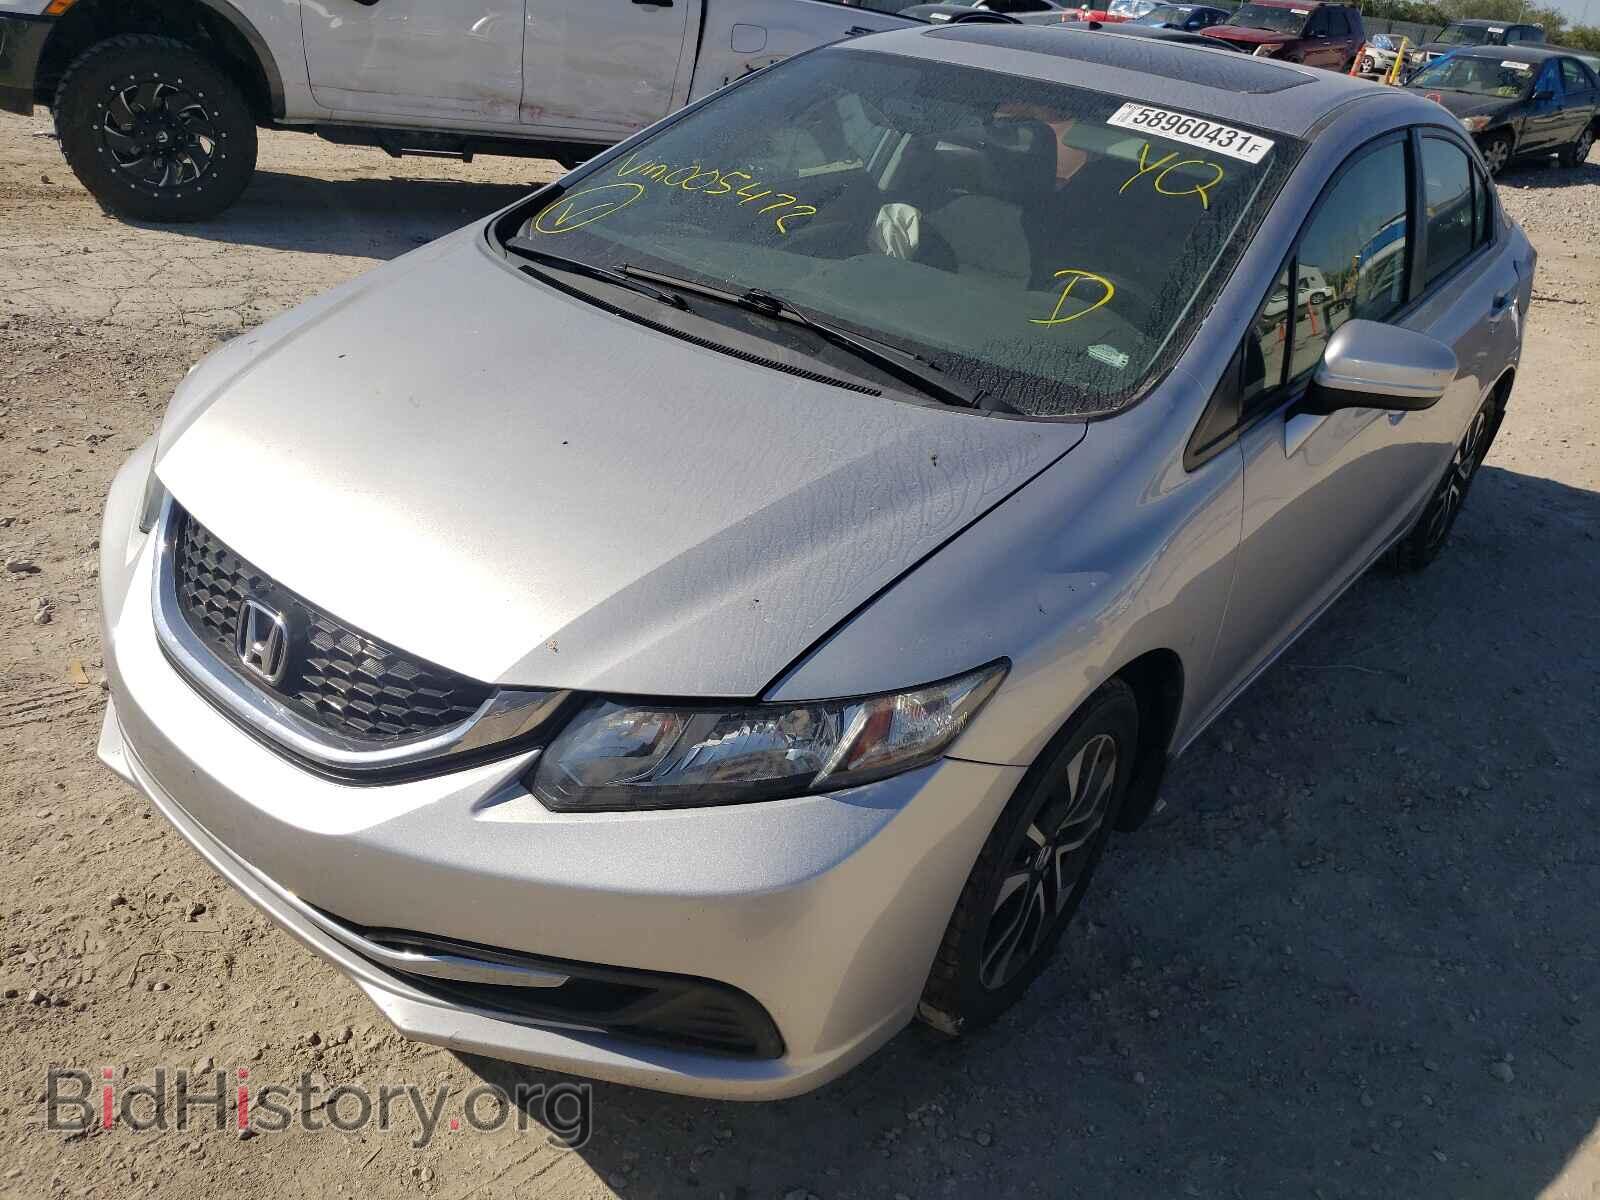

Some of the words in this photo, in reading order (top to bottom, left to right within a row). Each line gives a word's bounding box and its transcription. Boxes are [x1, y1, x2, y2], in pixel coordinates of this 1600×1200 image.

[1133, 108, 1252, 153] 58960431
[1247, 143, 1263, 154] F
[1027, 268, 1117, 329] D
